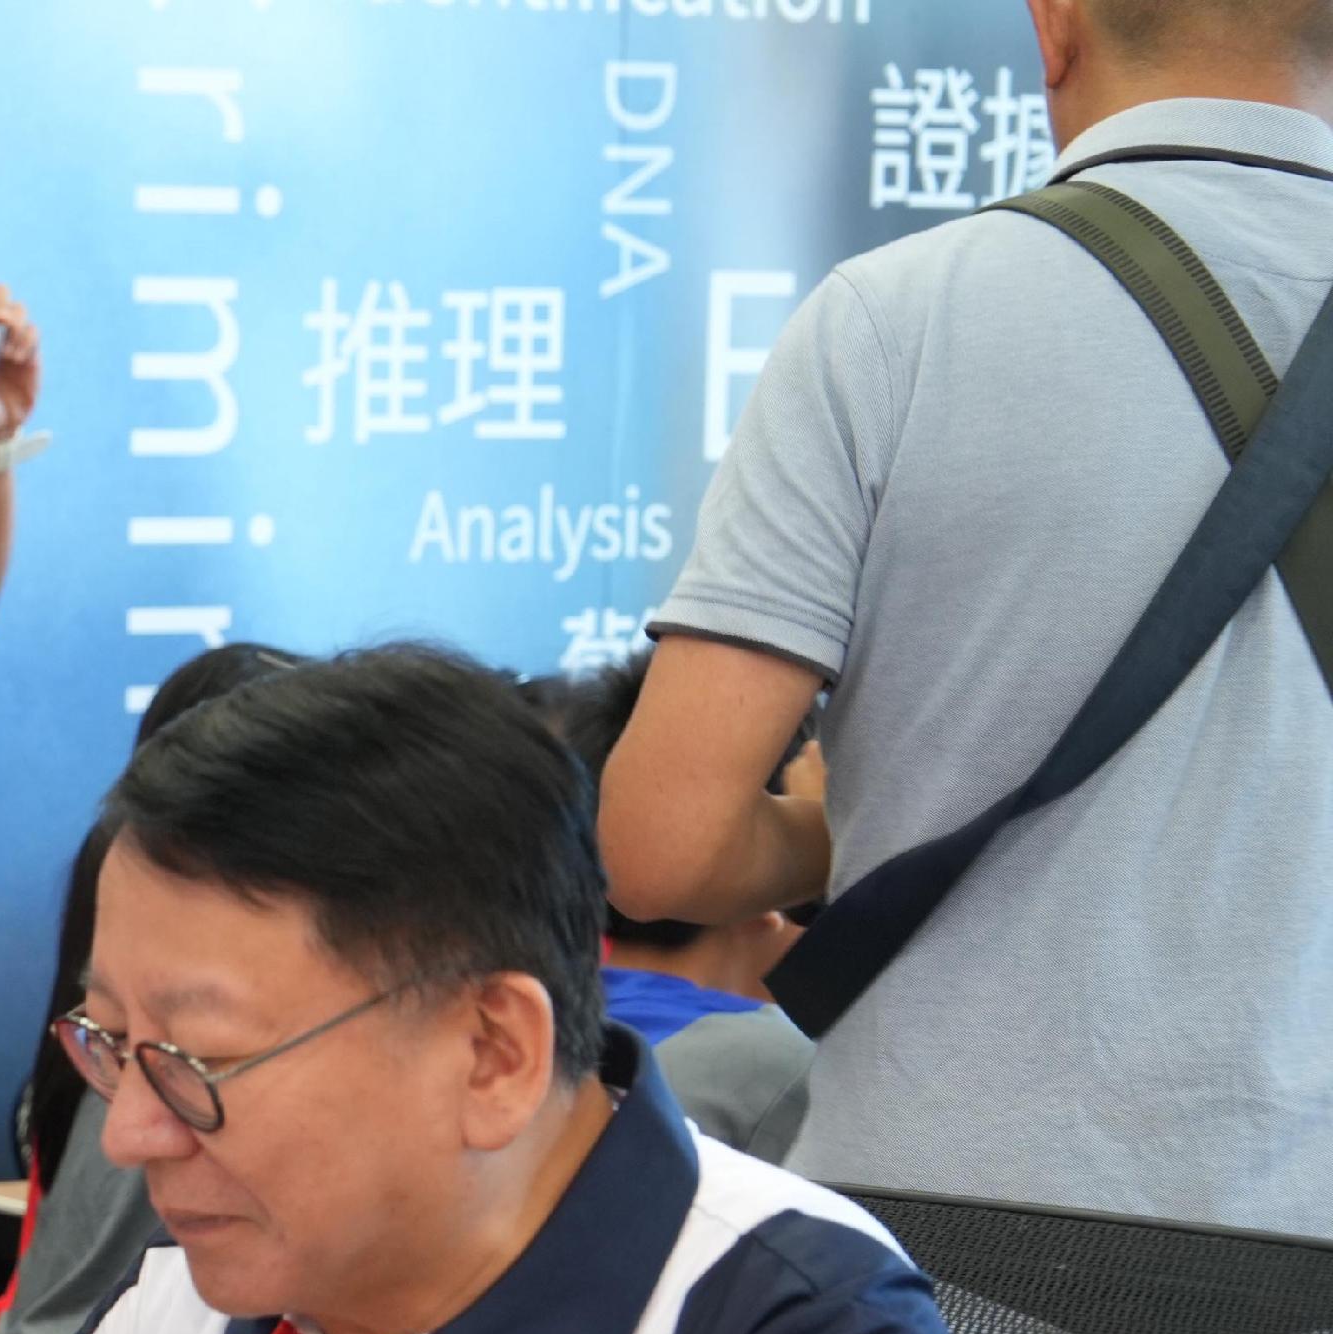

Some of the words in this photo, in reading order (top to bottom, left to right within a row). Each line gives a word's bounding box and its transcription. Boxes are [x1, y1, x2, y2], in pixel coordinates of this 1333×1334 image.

[599, 60, 677, 298] DNA
[302, 277, 566, 446] 推理
[409, 483, 674, 582] Analysis
